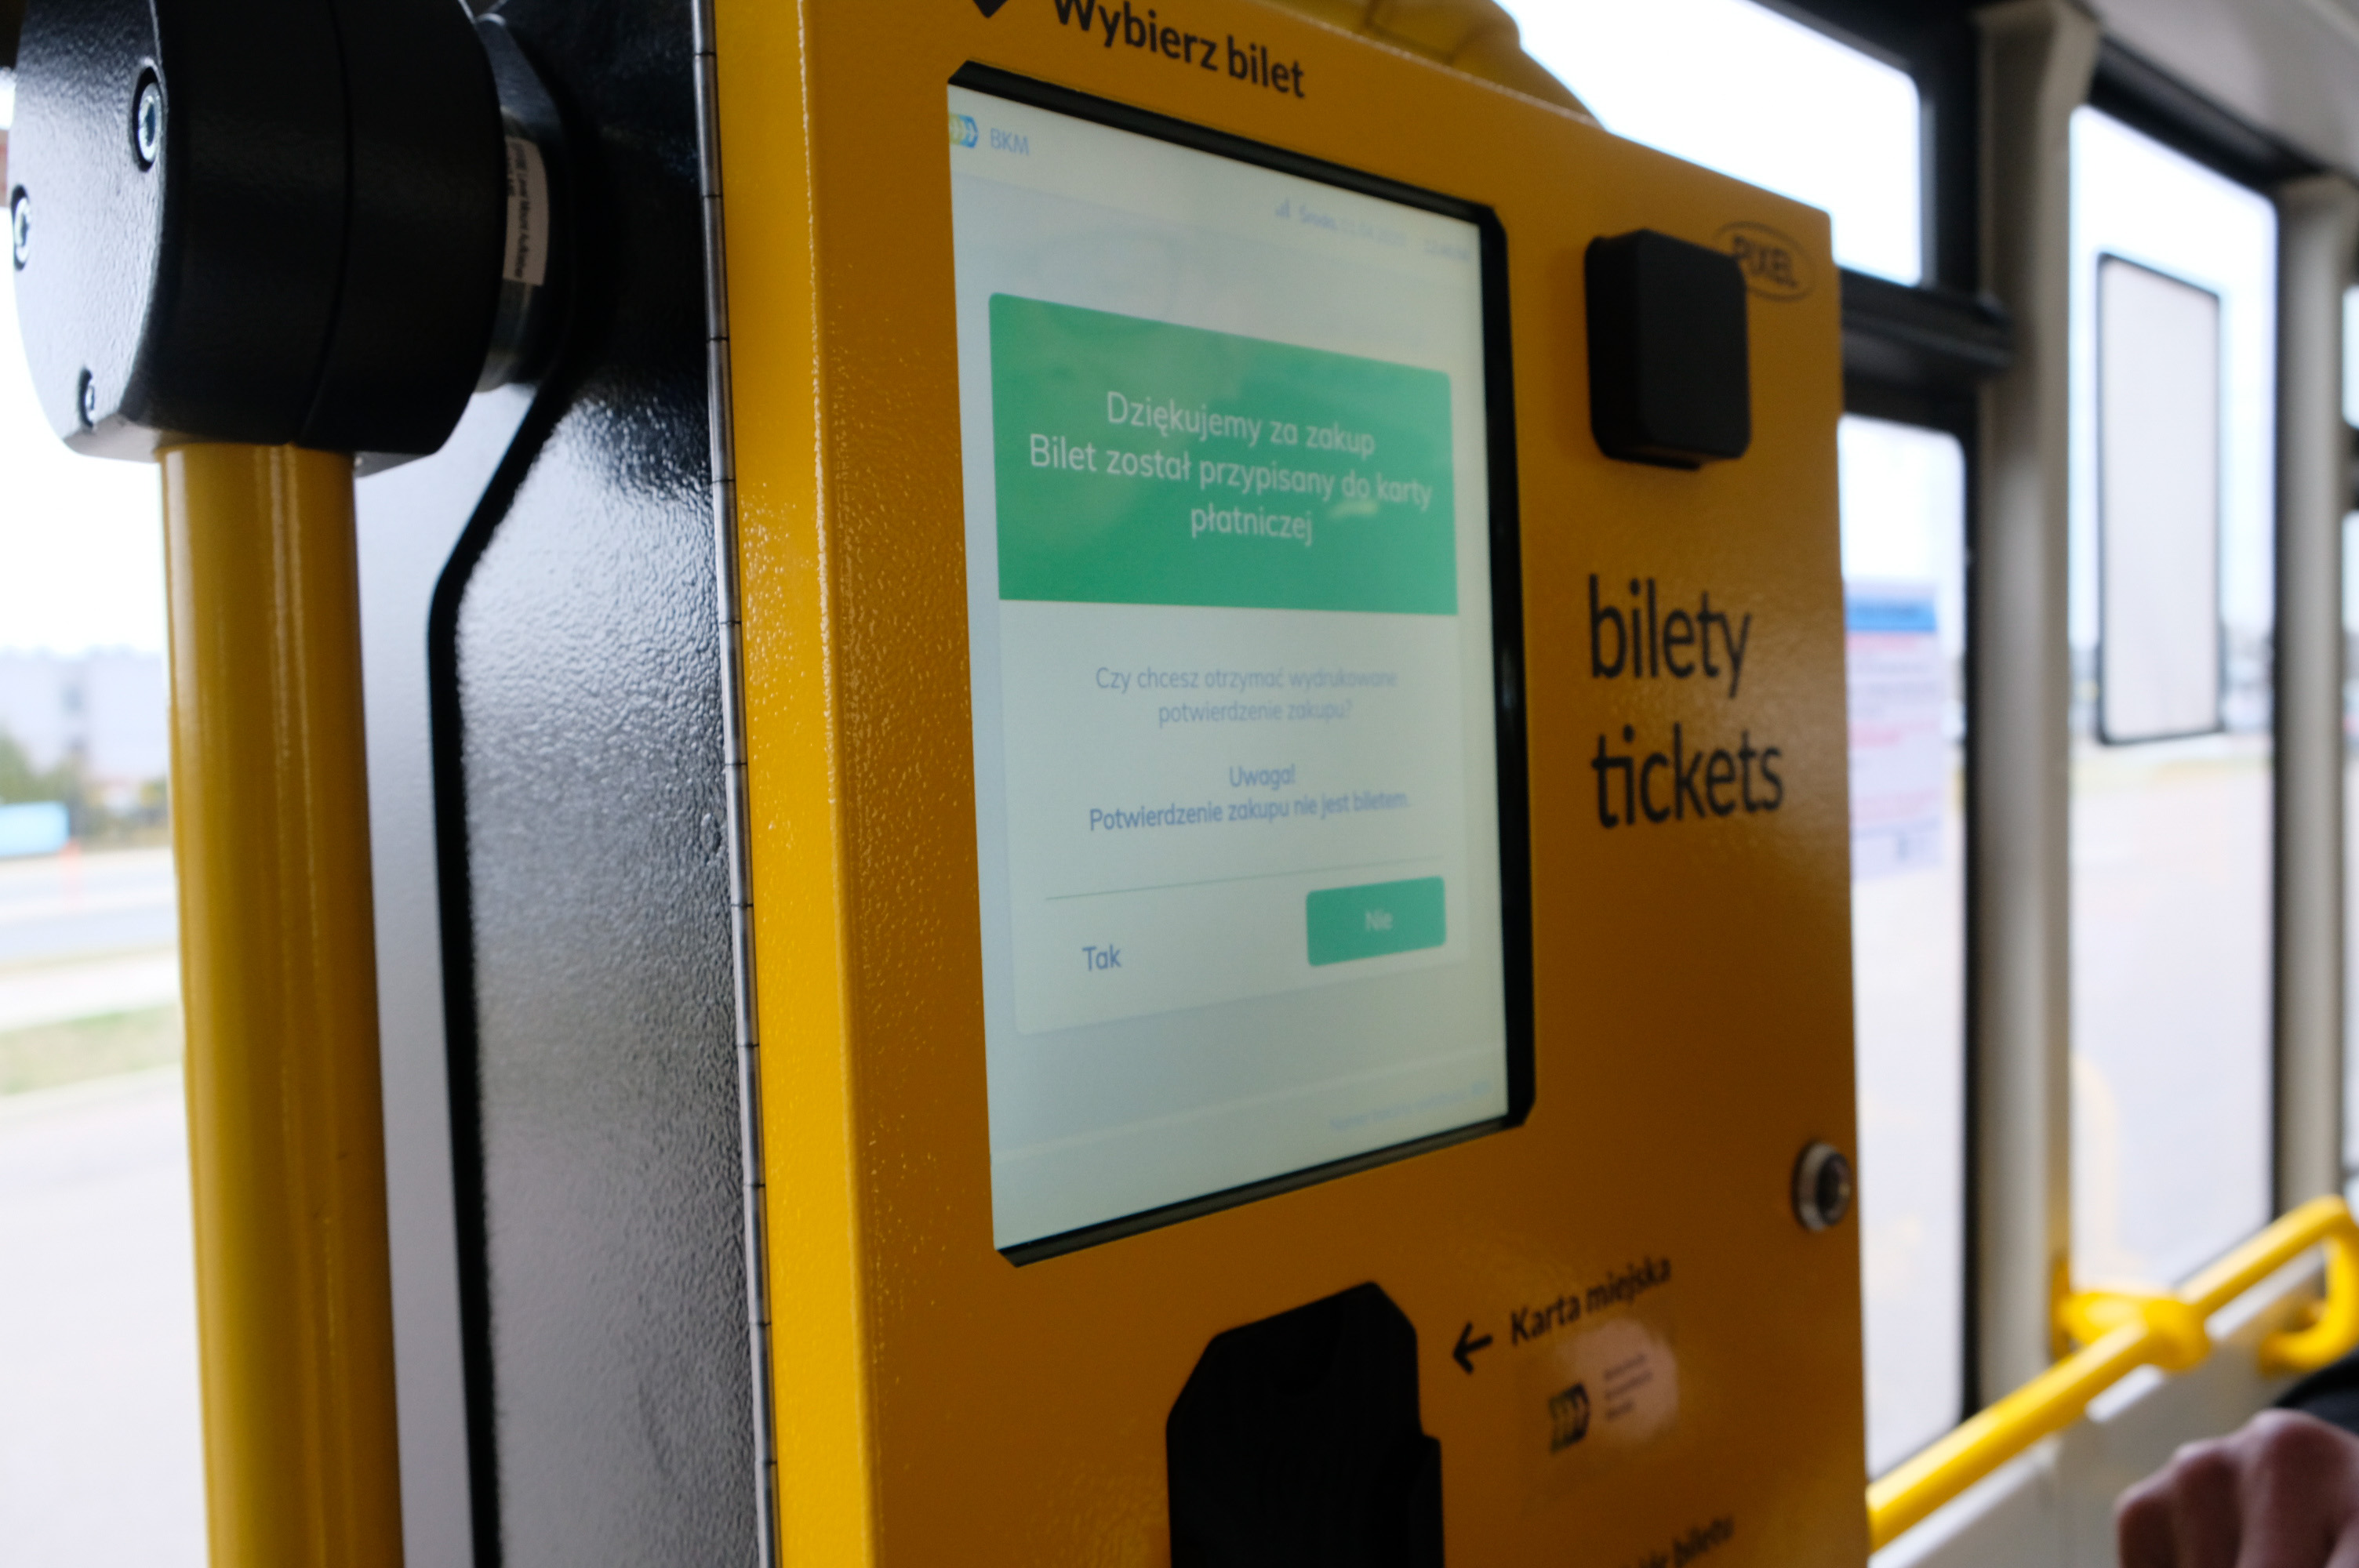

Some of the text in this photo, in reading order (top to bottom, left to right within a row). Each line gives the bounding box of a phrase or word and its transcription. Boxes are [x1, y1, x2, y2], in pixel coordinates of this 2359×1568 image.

[1054, 0, 1306, 99] Wybierz bilet
[990, 127, 1030, 157] BKM
[1107, 390, 1376, 461] Dziękujemy za zakup
[1029, 433, 1433, 511] Bilet został przypisany do karty
[1190, 503, 1314, 548] płatniczej
[1588, 573, 1753, 699] bilety
[1096, 666, 1398, 694] Czy chcesz otrzymać wydrukowane
[1158, 698, 1354, 728] potwierdzenie zakupu?
[1229, 763, 1296, 791] Uwaga!
[1590, 722, 1784, 829] tickets
[1089, 800, 1223, 832] Potwierdzenie
[1227, 797, 1290, 823] zakupu
[1295, 793, 1318, 816] nie
[1320, 793, 1350, 820] jest
[1365, 909, 1394, 932] Nie
[1082, 943, 1121, 972] Tak
[1510, 1255, 1672, 1346] Karta miejska
